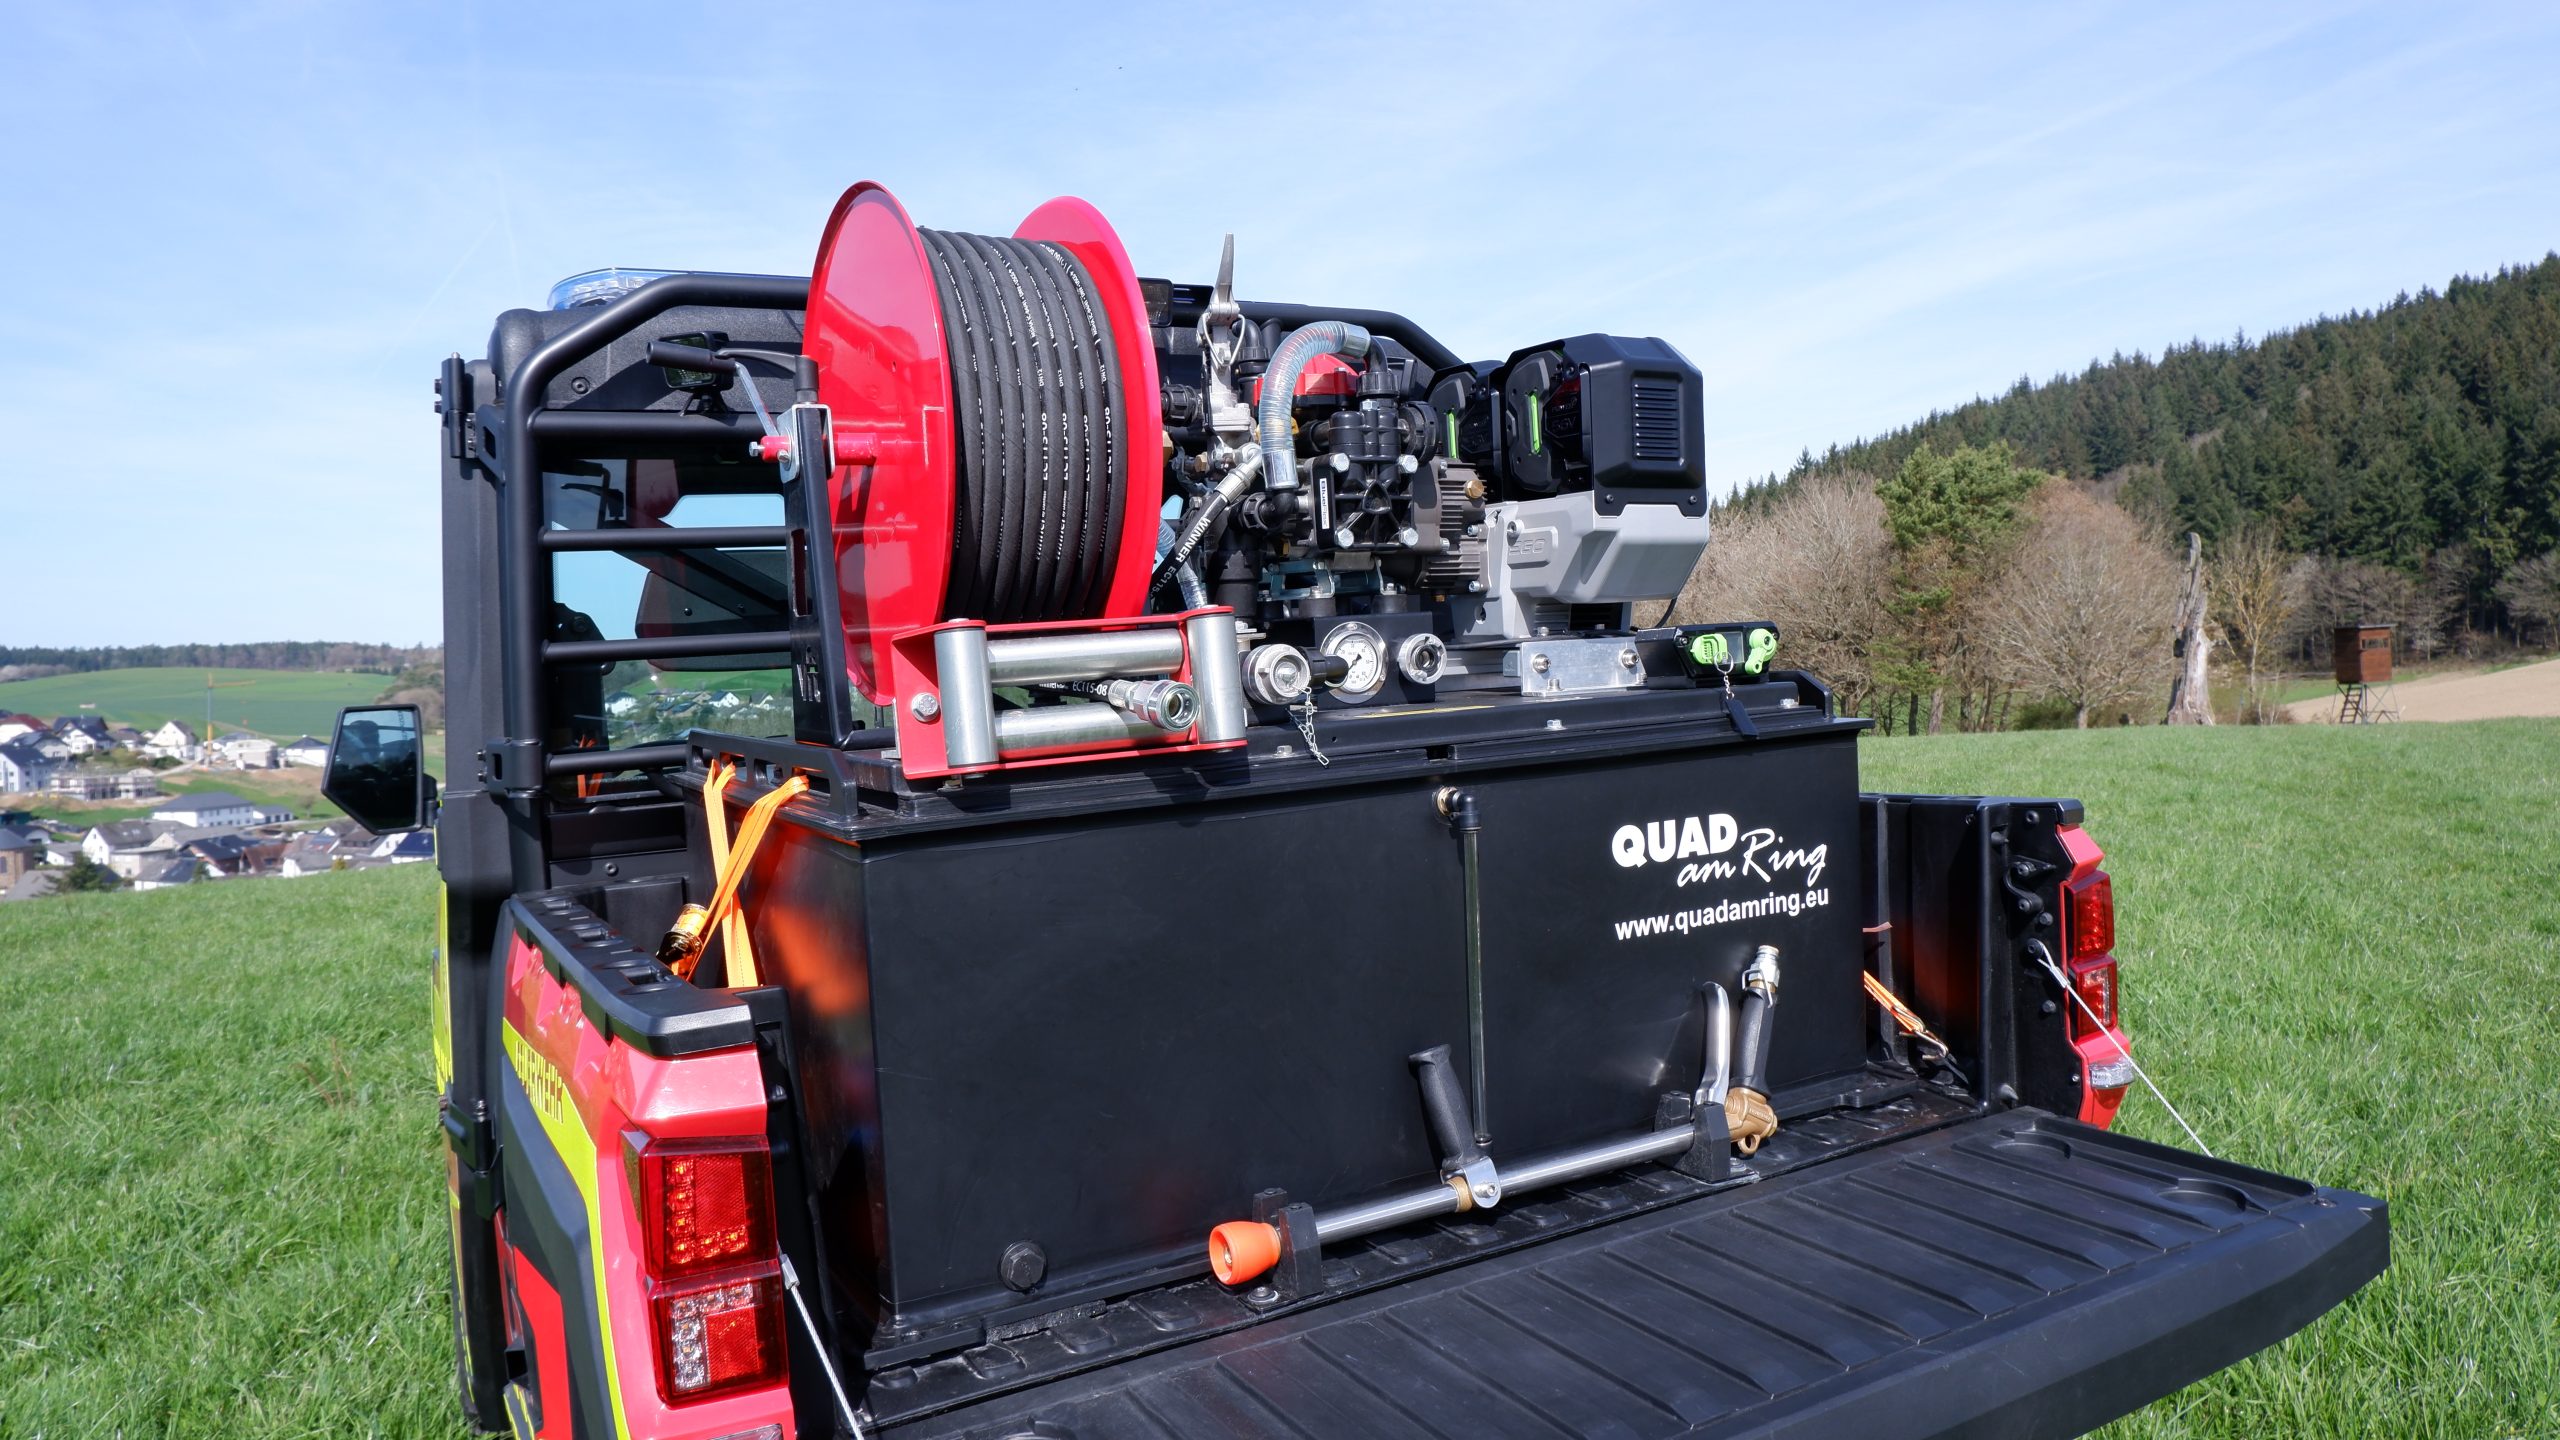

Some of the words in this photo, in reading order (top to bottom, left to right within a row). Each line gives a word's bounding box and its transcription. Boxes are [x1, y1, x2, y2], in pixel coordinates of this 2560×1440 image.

[1175, 516, 1211, 563] WINNER
[1072, 680, 1108, 696] EC115-08
[1611, 813, 1739, 868] QUAD
[1677, 859, 1736, 887] am
[1740, 828, 1828, 887] Ring
[1614, 888, 1829, 941] www.quadamring.eu
